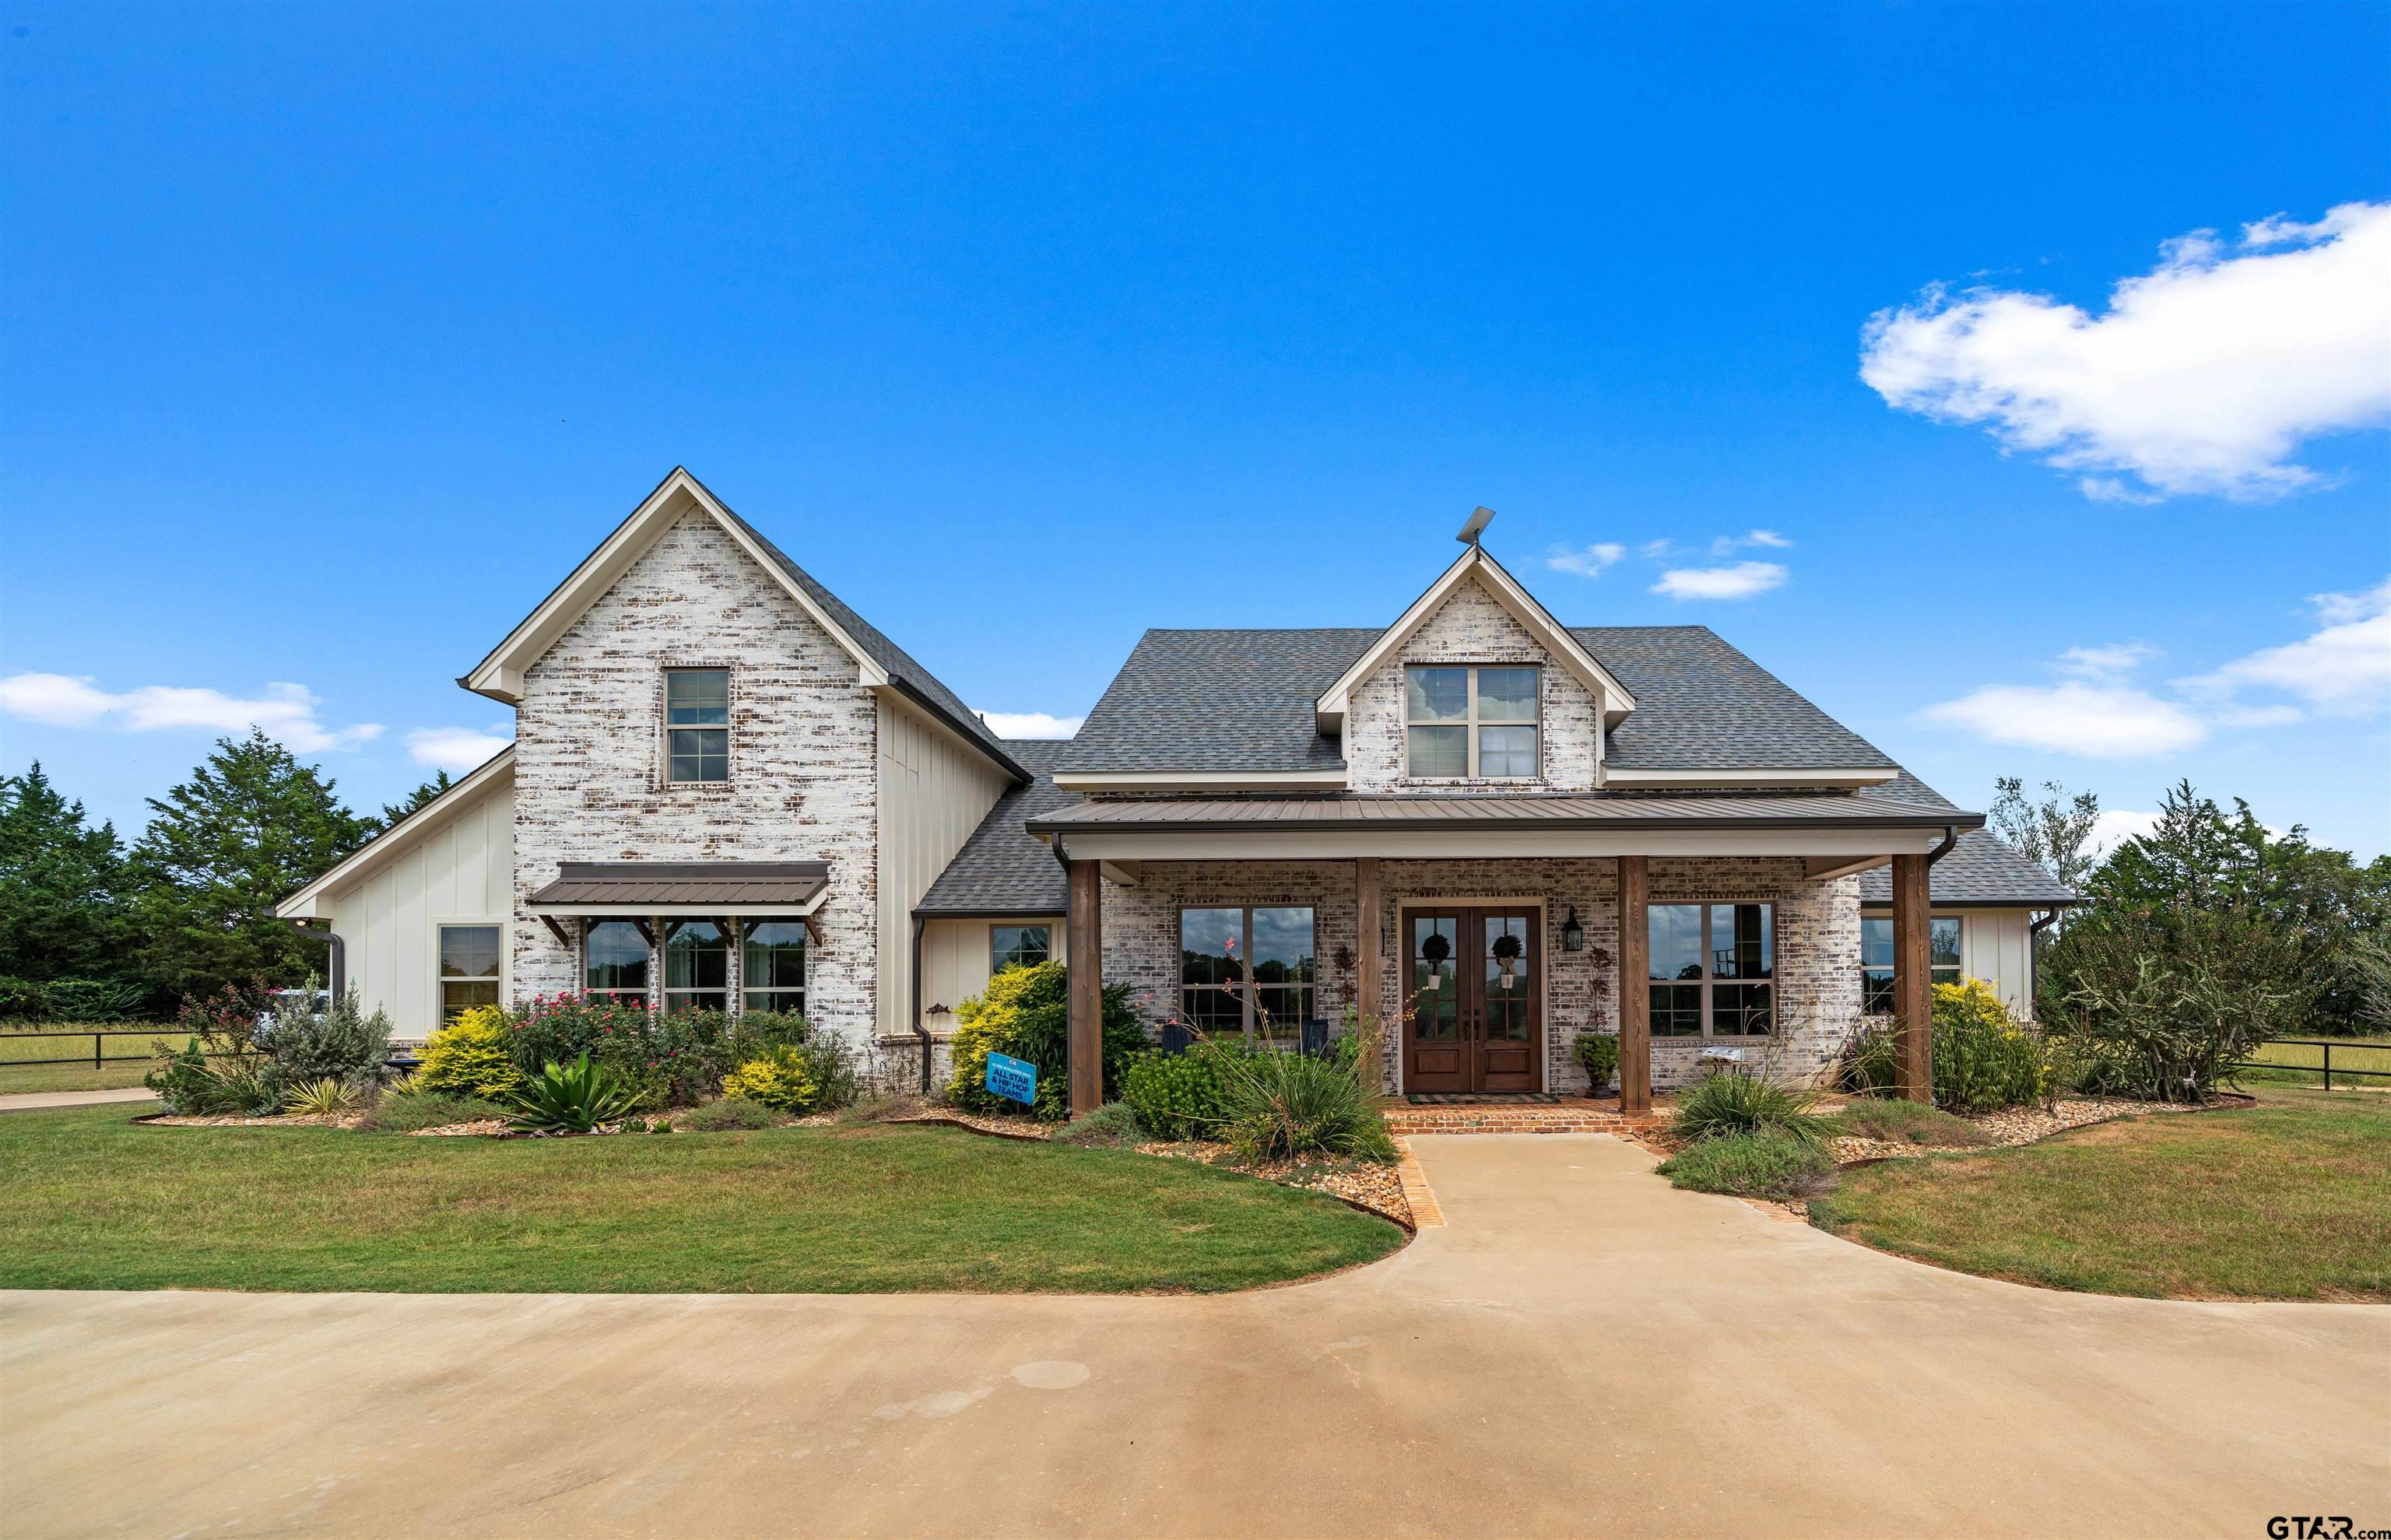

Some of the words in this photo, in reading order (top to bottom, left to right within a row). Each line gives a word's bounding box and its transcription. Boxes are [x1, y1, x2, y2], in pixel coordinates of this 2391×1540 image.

[994, 1069, 1008, 1079] ALL
[1009, 1074, 1028, 1085] STAR
[998, 1086, 1023, 1099] TEAMS
[999, 1079, 1012, 1087] HIP
[1013, 1082, 1029, 1093] HOP
